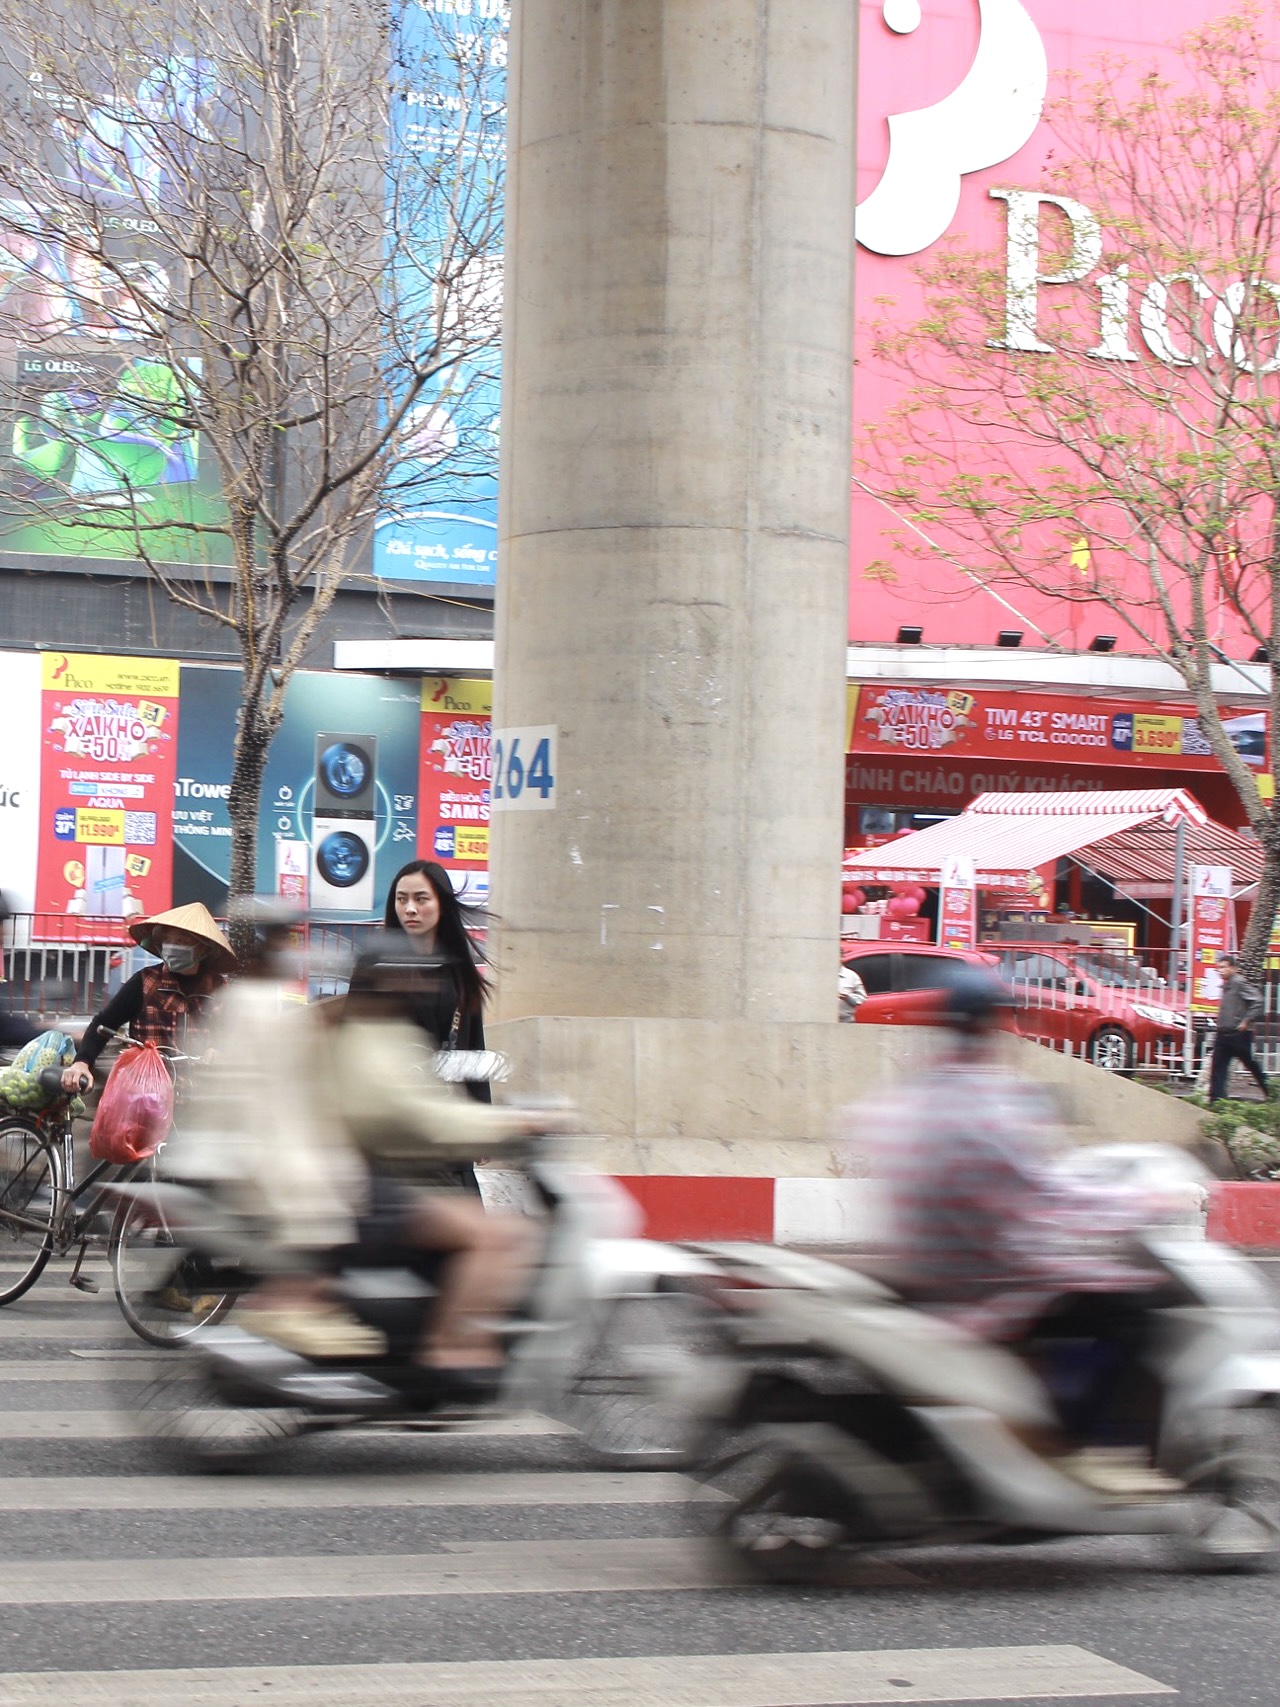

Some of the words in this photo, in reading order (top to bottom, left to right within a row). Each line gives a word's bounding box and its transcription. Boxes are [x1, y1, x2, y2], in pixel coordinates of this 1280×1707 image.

[25, 360, 42, 371] LG
[985, 708, 1017, 726] TIVI
[1051, 711, 1108, 732] SMART
[998, 730, 1014, 740] LG
[1017, 730, 1048, 743] TCL
[173, 778, 232, 799] Towe
[899, 766, 965, 795] CHÀO
[970, 771, 1019, 794] QUÝ
[440, 803, 491, 820] SAMS
[211, 826, 234, 836] MIN
